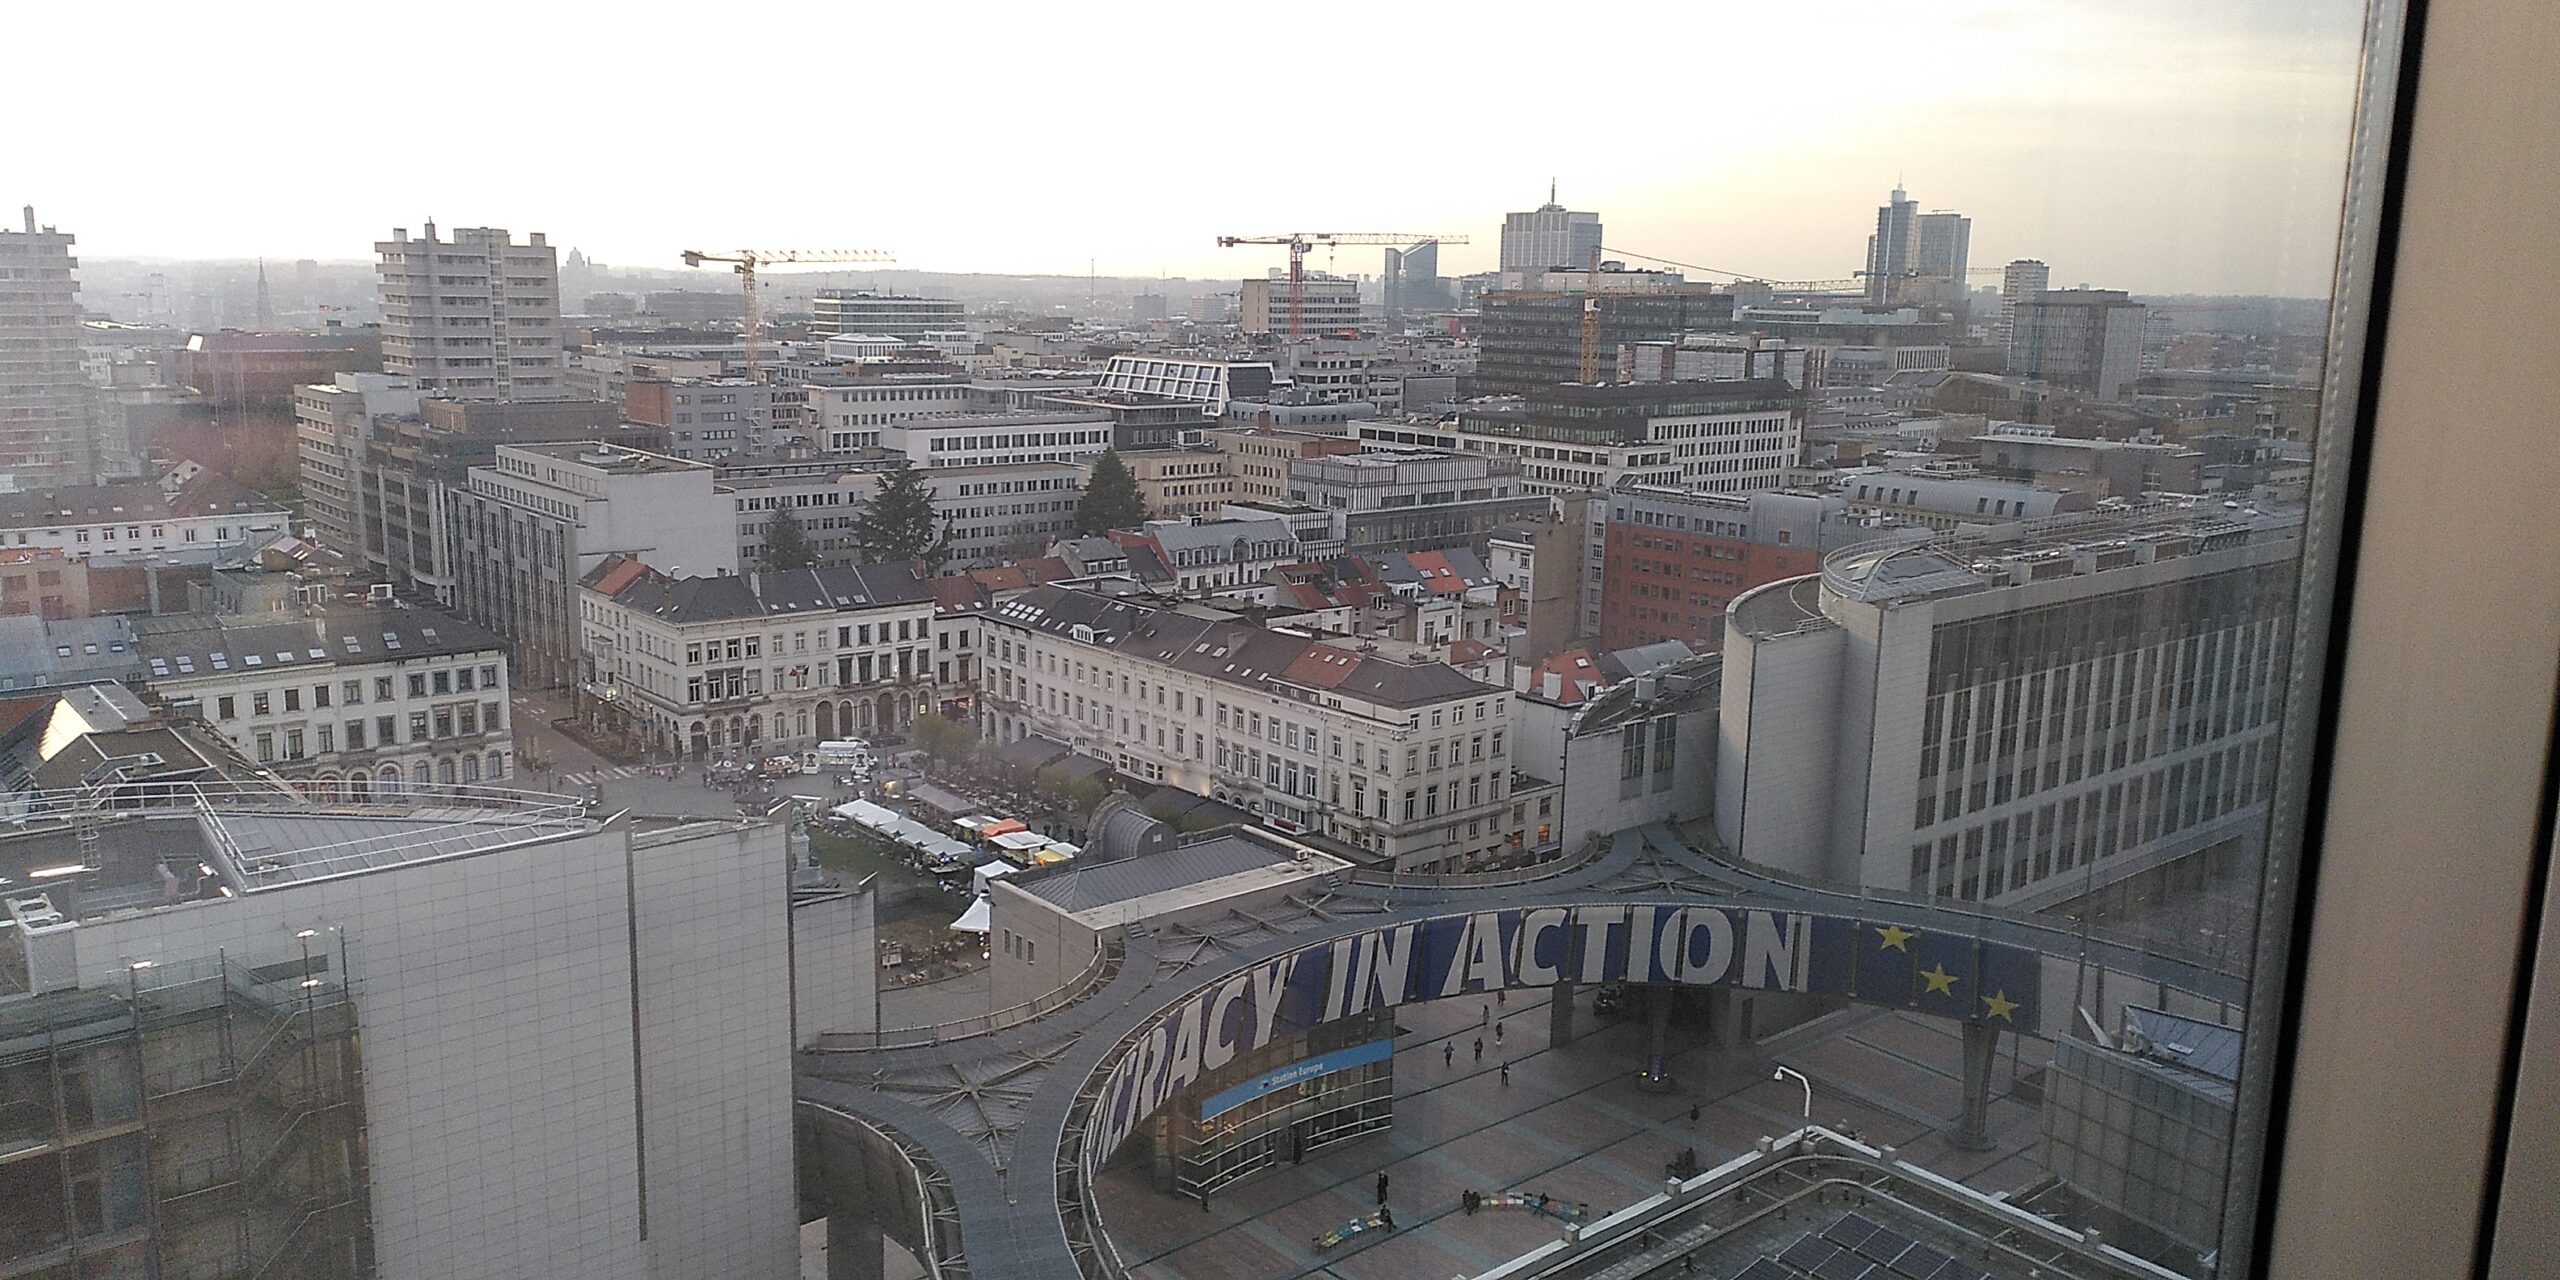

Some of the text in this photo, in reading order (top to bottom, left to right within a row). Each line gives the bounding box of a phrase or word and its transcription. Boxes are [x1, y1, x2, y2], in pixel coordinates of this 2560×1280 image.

[1322, 925, 1415, 1022] IN
[1440, 904, 1811, 998] ACTION
[1271, 1071, 1298, 1086] Station
